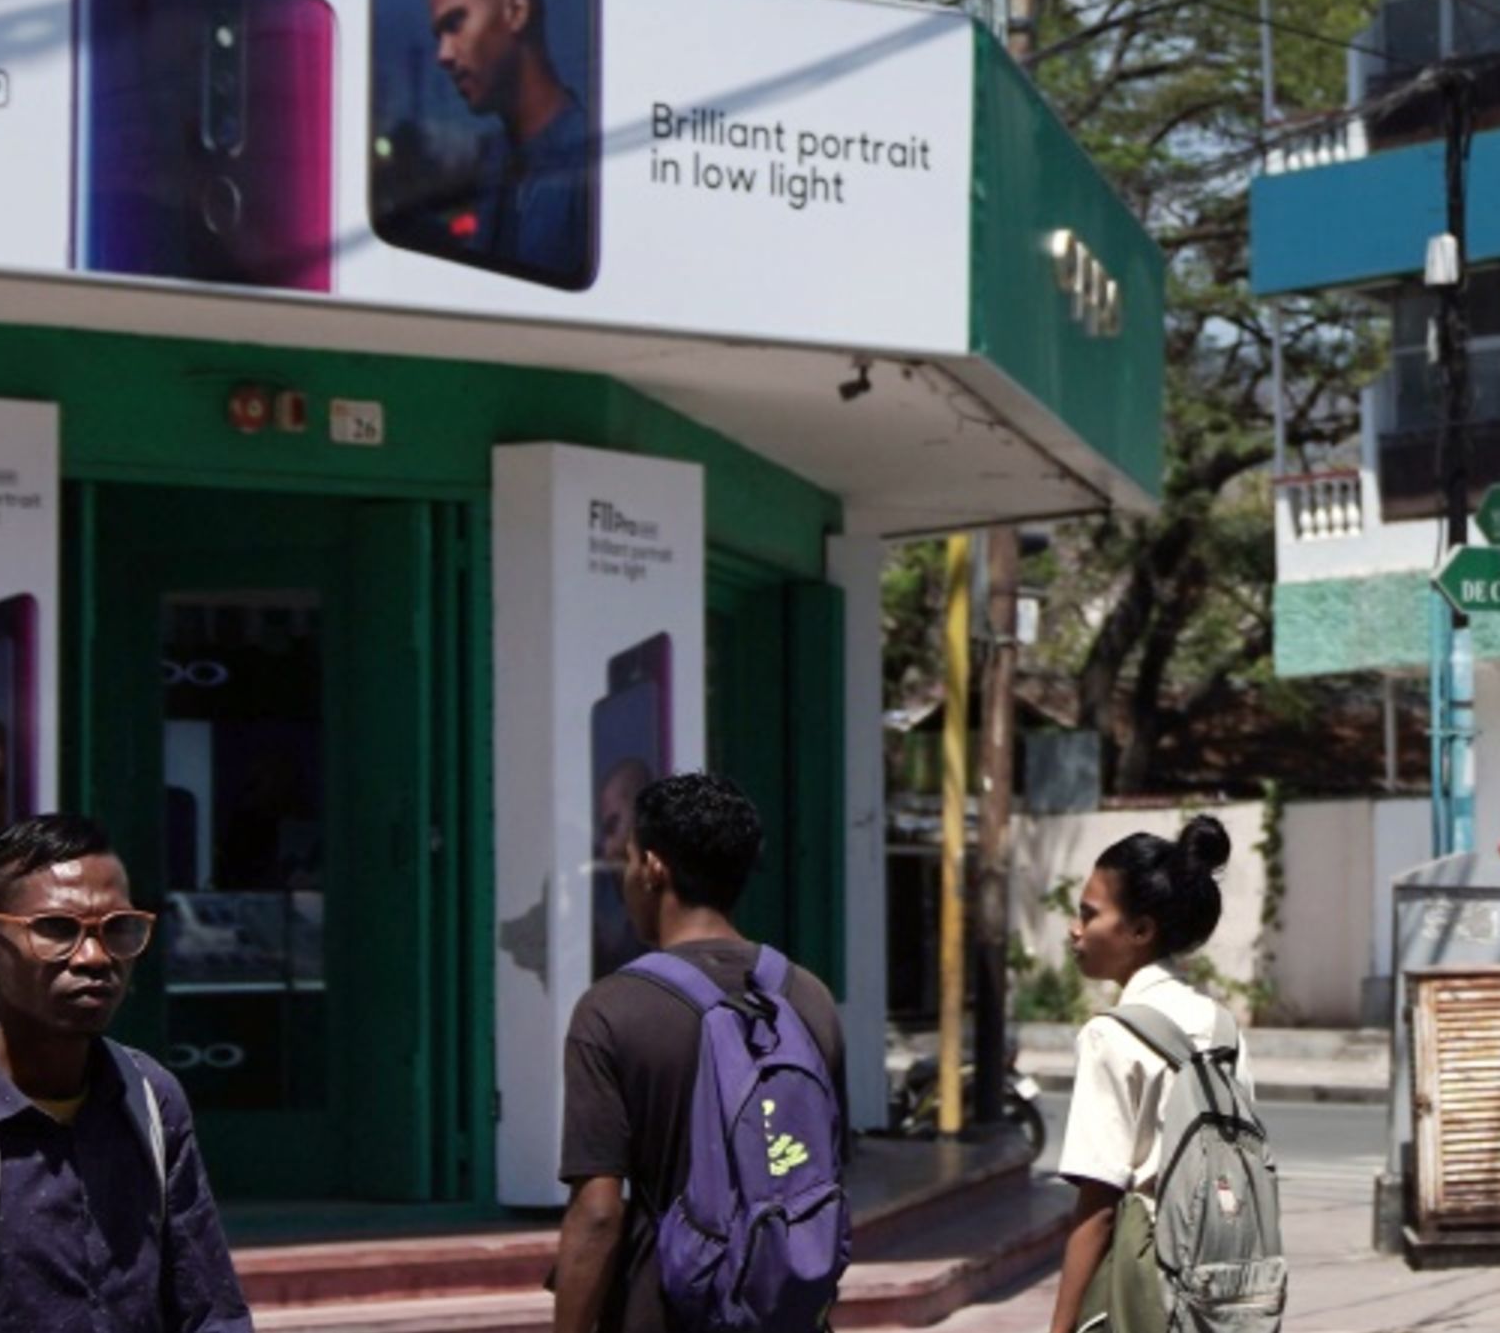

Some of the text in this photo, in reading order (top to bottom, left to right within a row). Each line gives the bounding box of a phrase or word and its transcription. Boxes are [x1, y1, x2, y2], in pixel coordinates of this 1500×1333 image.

[650, 103, 931, 173] Brilliant portrait
[650, 149, 846, 212] in low light
[1461, 580, 1487, 603] DE
